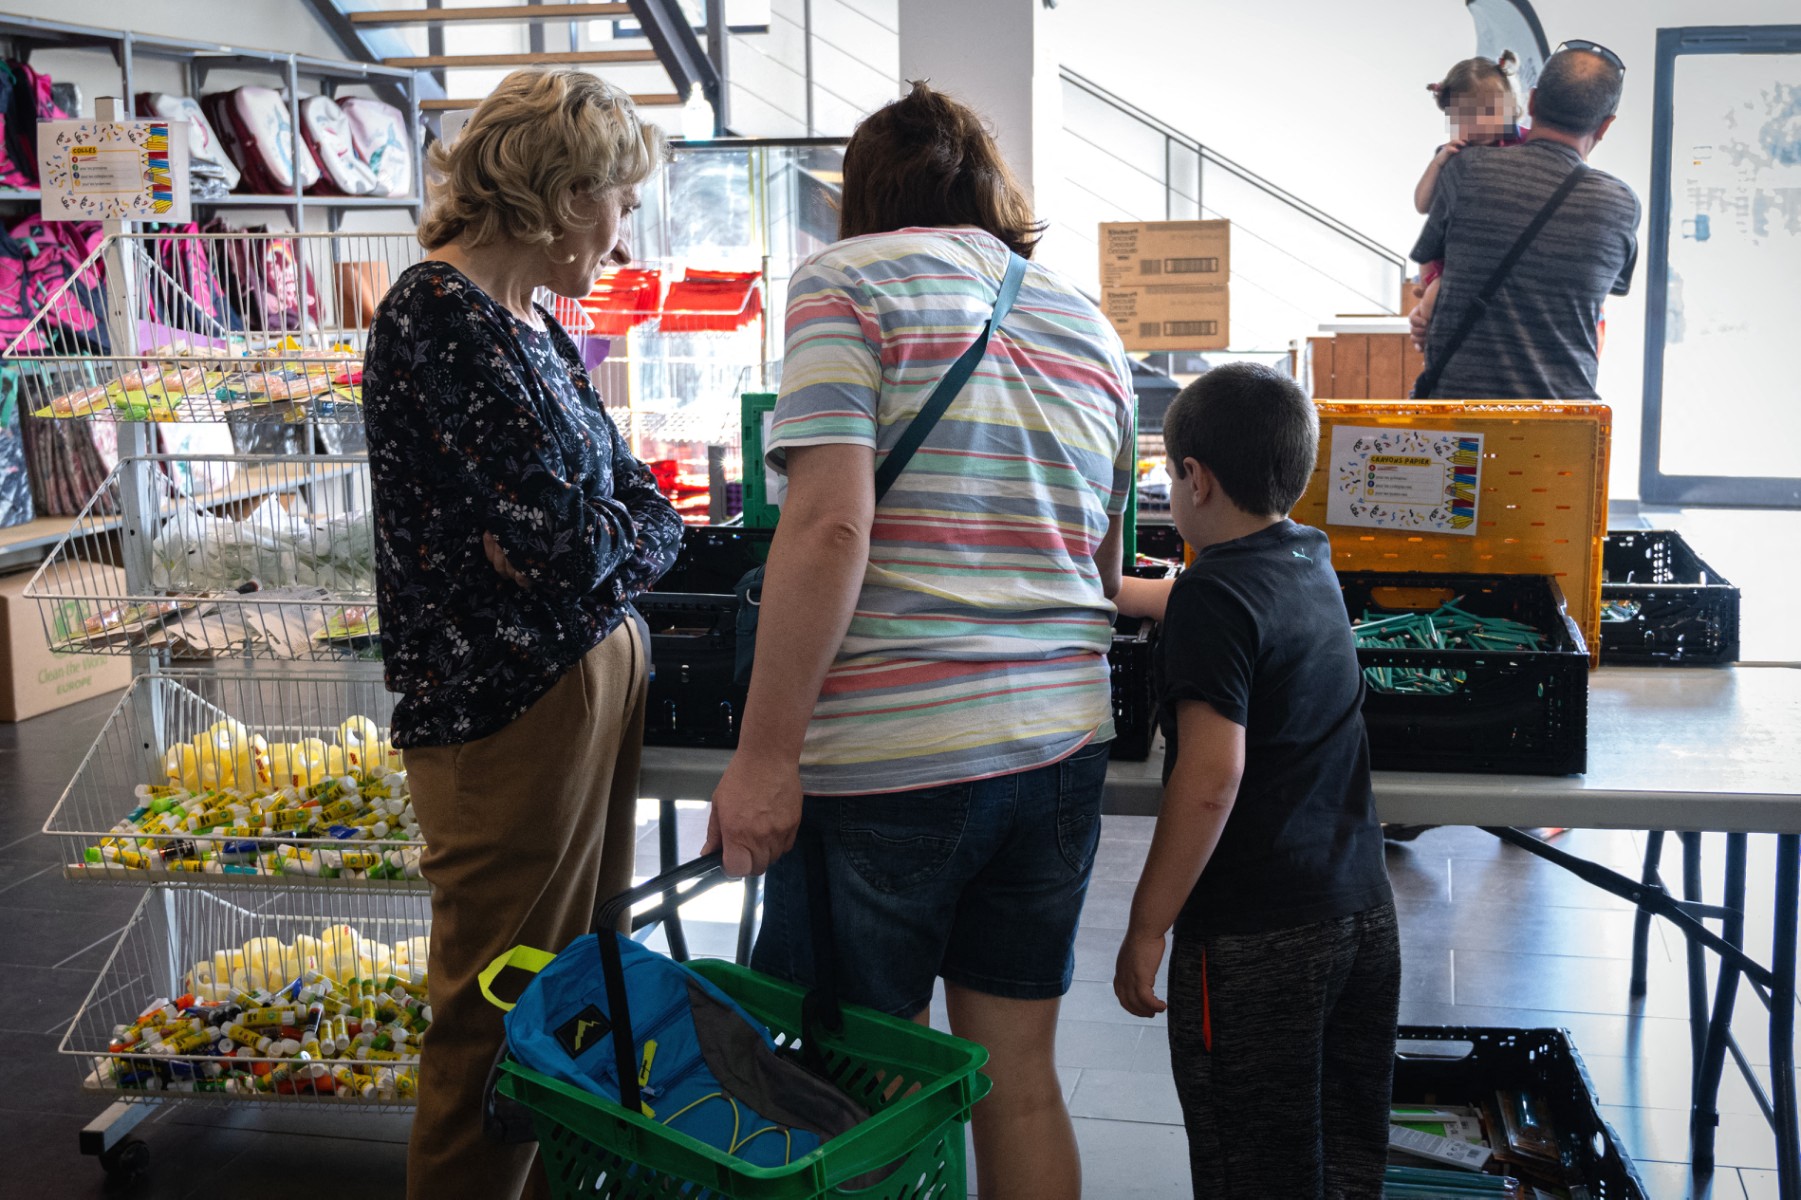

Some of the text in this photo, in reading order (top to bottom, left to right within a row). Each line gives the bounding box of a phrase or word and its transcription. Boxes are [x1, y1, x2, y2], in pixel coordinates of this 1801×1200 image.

[1371, 456, 1403, 464] CRAYONS
[38, 656, 108, 684] Clean the World
[57, 675, 92, 695] EUROPE
